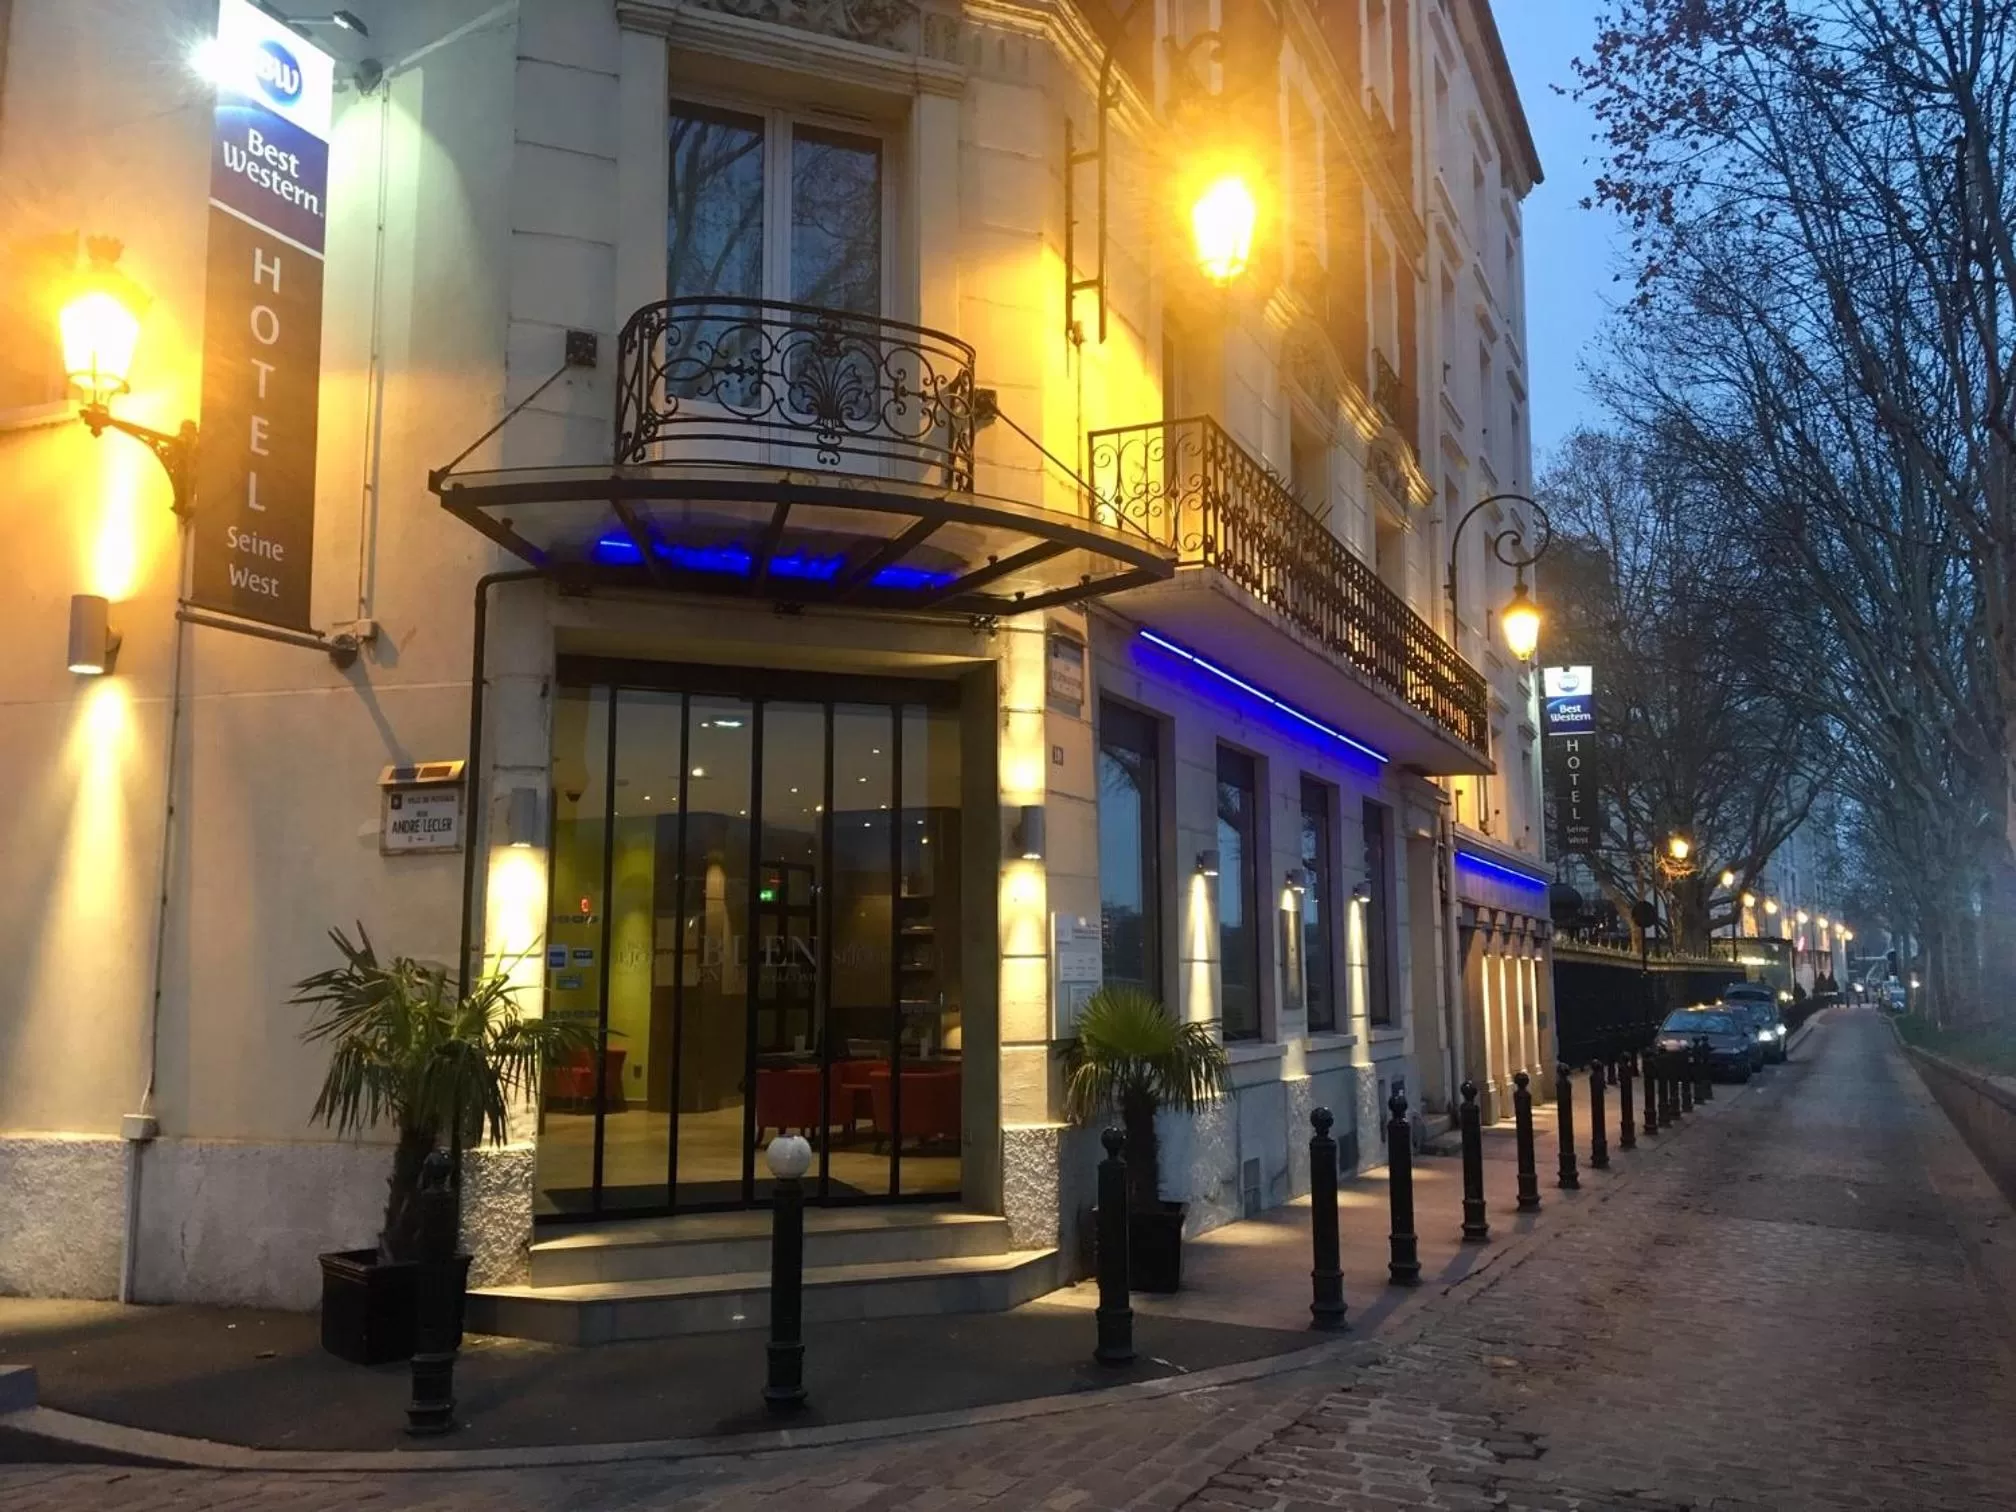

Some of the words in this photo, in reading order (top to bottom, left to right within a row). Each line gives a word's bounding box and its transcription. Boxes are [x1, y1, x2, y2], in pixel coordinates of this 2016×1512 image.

[248, 128, 300, 178] Best
[223, 141, 320, 216] Western
[248, 247, 281, 512] HOTEL
[227, 526, 284, 562] Seine
[229, 563, 280, 597] West
[1550, 712, 1591, 723] Western
[1559, 703, 1582, 713] Best
[1566, 739, 1582, 820] HOTEL
